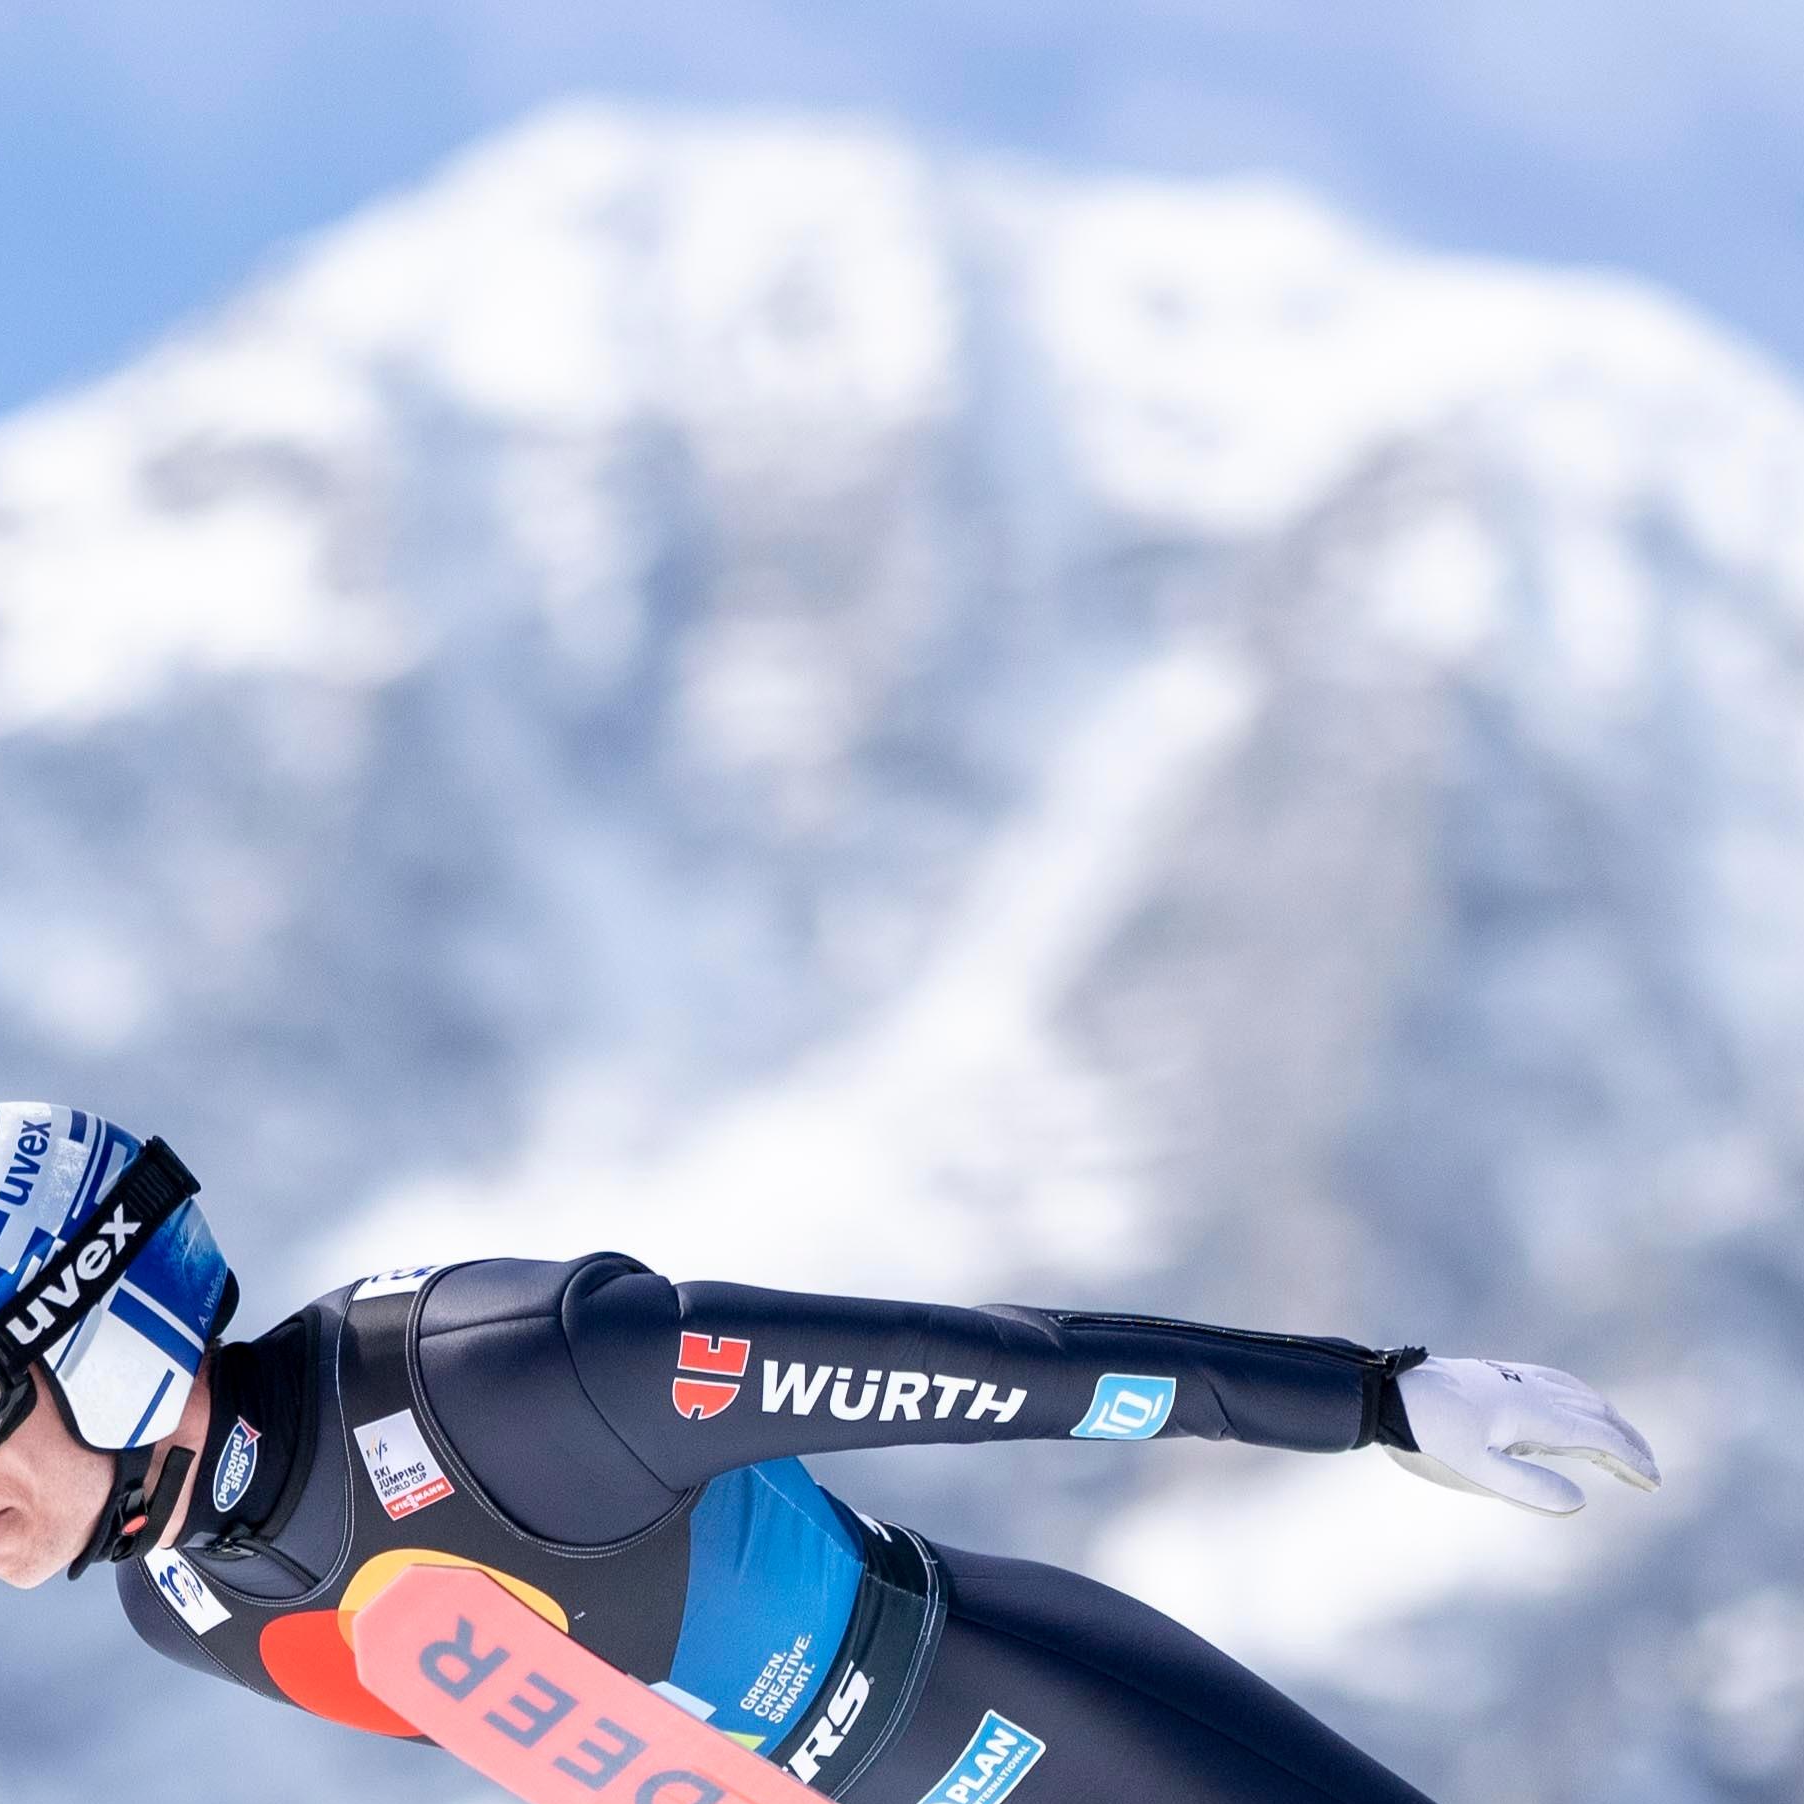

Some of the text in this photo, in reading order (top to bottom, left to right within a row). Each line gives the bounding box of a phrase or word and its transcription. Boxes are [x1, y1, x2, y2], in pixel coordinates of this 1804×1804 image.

[6, 1202, 143, 1346] uvex
[761, 1359, 1028, 1424] WÜRTH
[217, 1434, 244, 1505] personal
[231, 1452, 250, 1492] shop
[373, 1465, 392, 1481] SKI
[378, 1461, 426, 1491] JUMPING
[382, 1472, 428, 1498] WORLD CUP
[740, 1651, 788, 1711] GREEN.
[754, 1633, 813, 1717] CREATIVE.
[768, 1662, 816, 1724] SMART.
[945, 1727, 1019, 1804] PLAN
